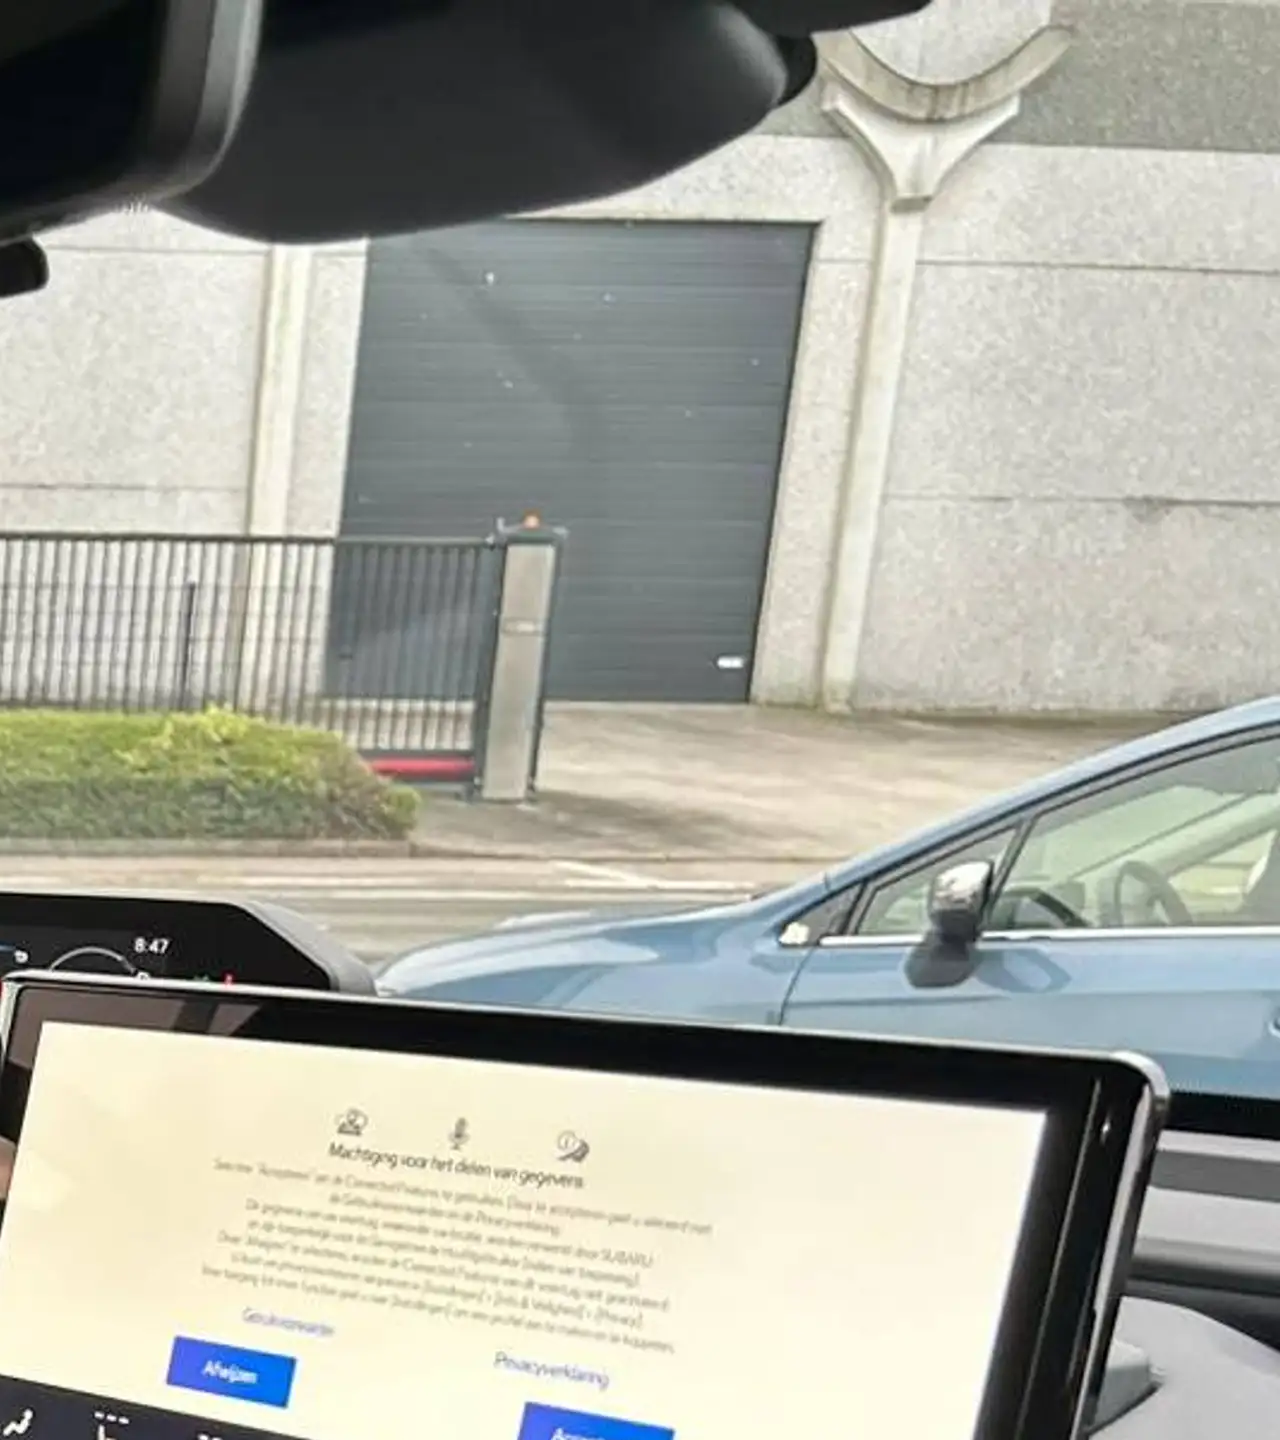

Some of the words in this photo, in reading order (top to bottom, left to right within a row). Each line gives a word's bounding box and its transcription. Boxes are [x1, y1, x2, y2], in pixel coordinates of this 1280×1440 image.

[134, 937, 169, 954] 8:47
[329, 1141, 399, 1169] Machtiging
[401, 1154, 428, 1169] voor
[430, 1155, 454, 1172] het
[454, 1160, 491, 1176] delen
[493, 1166, 518, 1179] van
[519, 1168, 585, 1189] gegevens
[493, 1350, 610, 1391] Privacyverklaring
